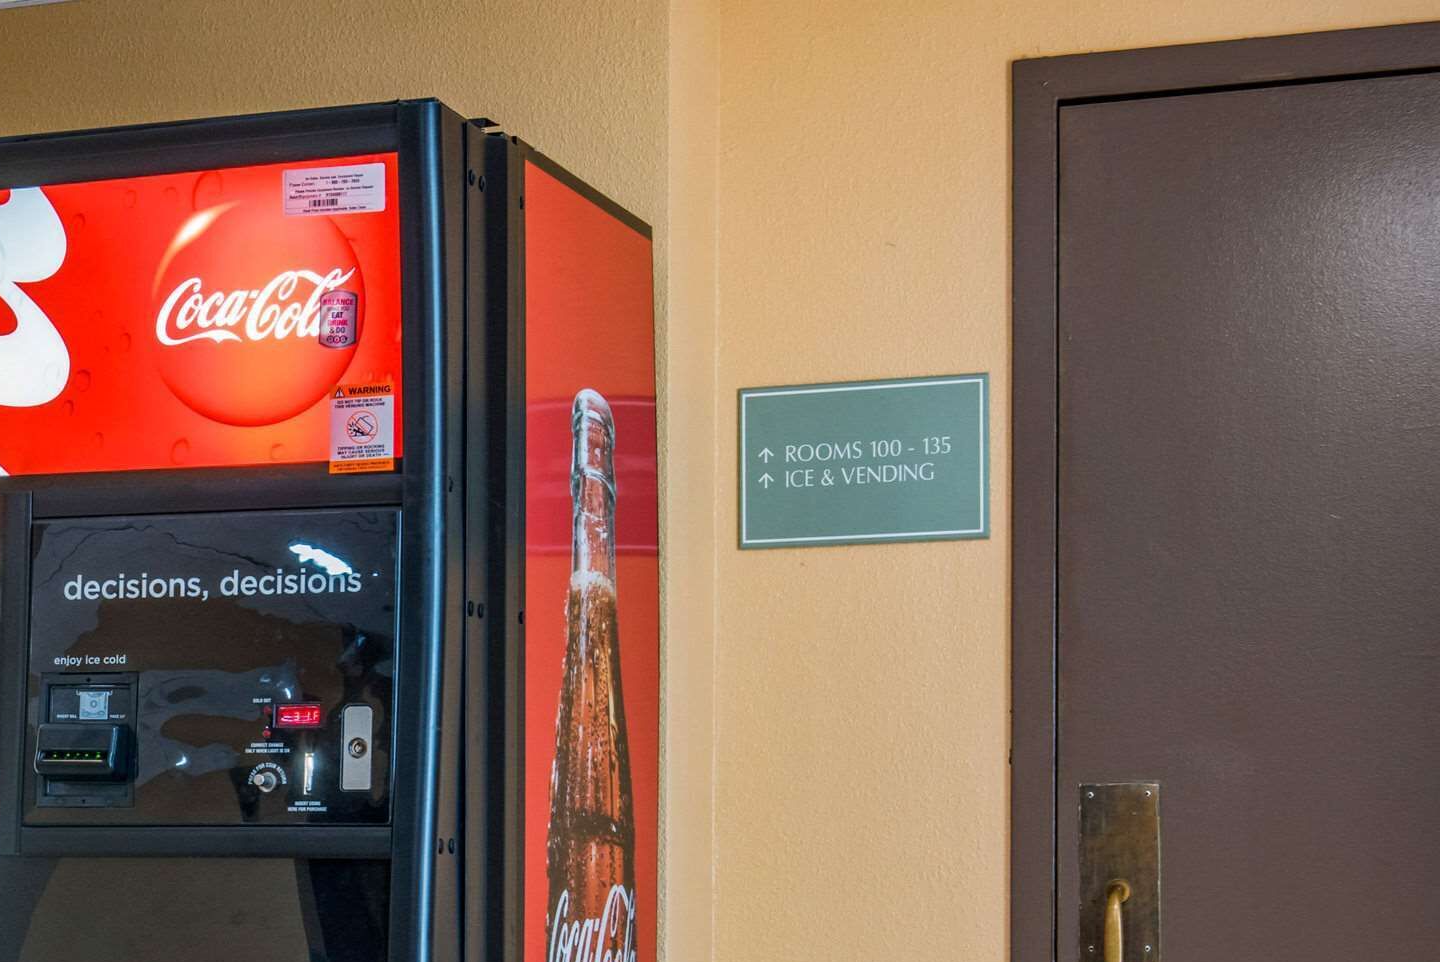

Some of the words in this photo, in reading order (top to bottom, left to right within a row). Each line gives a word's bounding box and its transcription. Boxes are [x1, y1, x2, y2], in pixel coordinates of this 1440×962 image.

[348, 384, 391, 395] WARNING
[785, 441, 862, 463] ROOMS
[870, 439, 902, 458] 100
[922, 436, 952, 456] 135
[785, 469, 814, 488] ICE
[820, 468, 834, 486] &
[841, 462, 935, 484] VENDING
[63, 572, 208, 601] decisions,
[219, 568, 362, 596] decisions
[54, 655, 82, 666] enjoy
[85, 654, 100, 664] ice
[103, 654, 126, 664] cold
